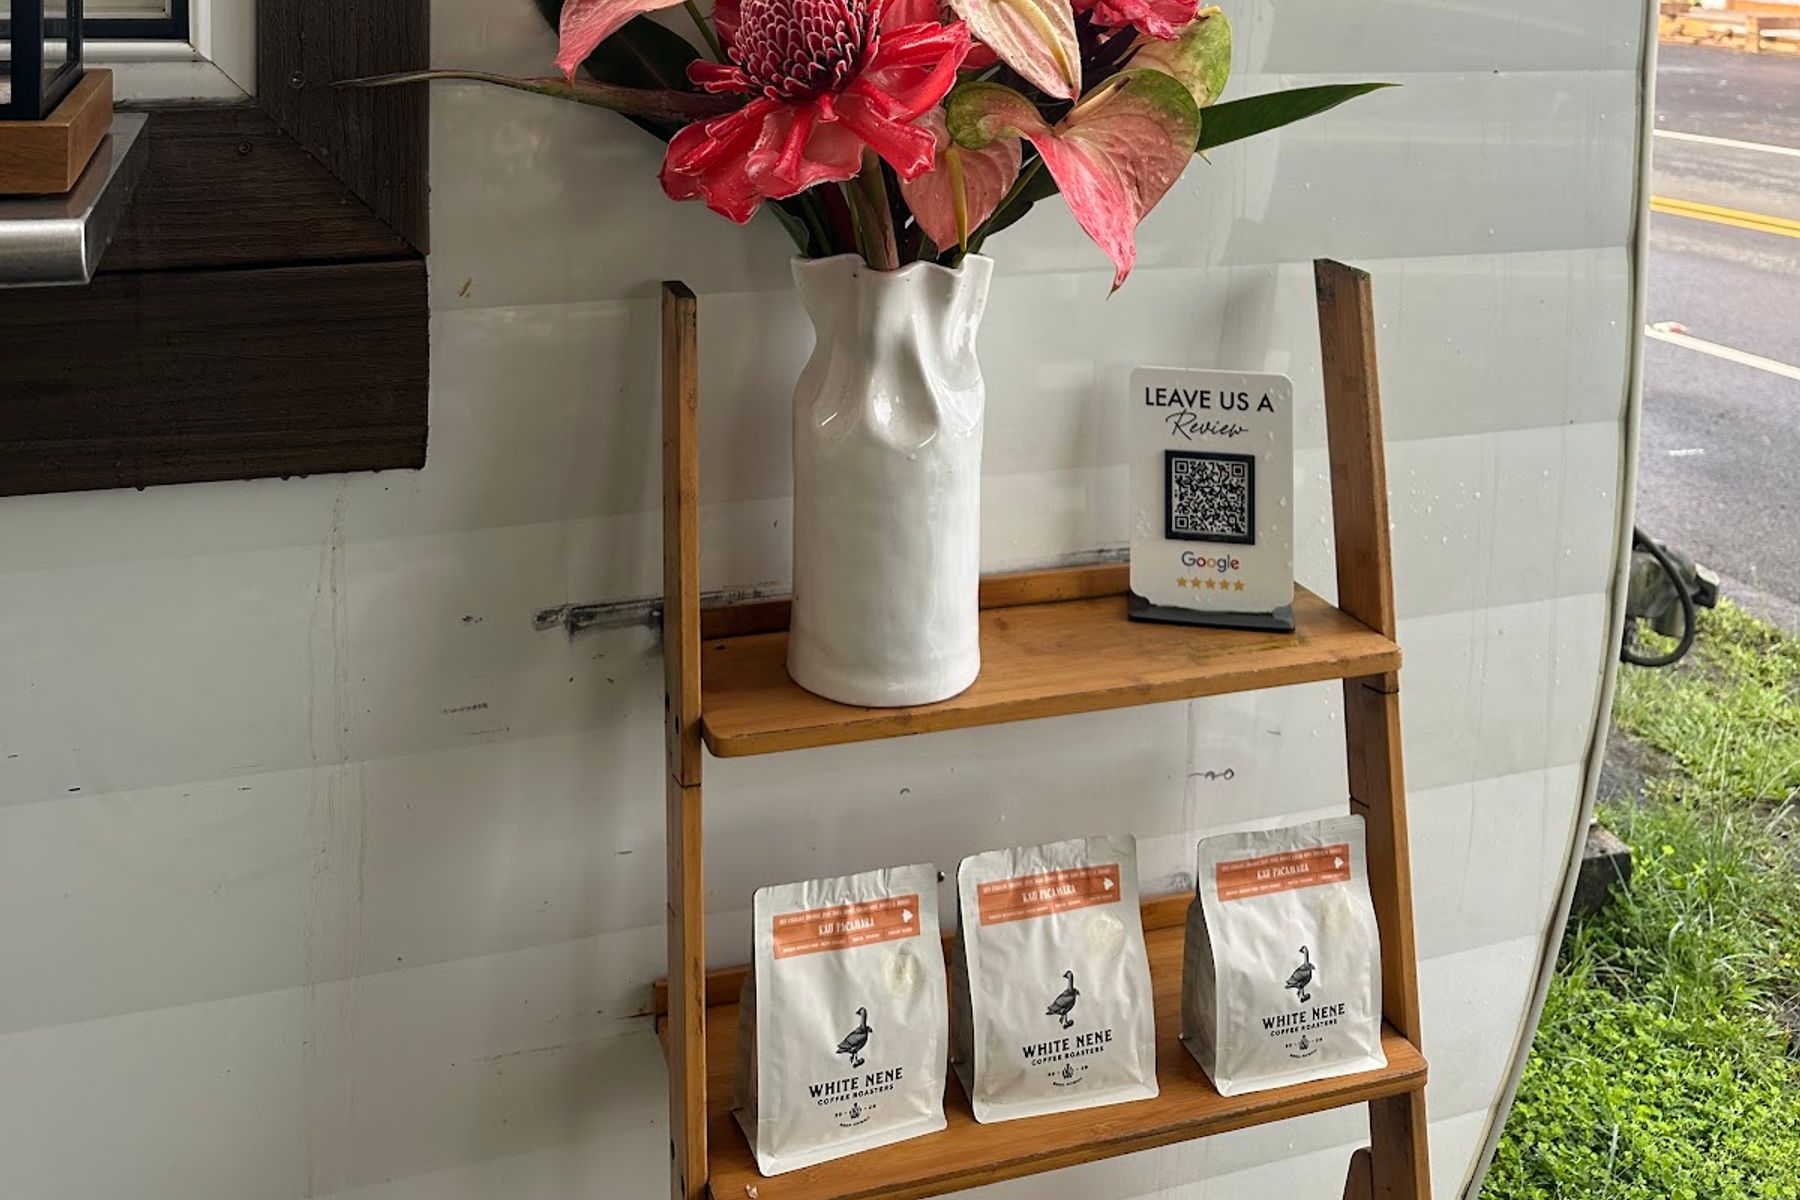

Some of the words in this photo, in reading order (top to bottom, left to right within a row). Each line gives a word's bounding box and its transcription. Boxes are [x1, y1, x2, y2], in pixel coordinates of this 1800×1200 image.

[1146, 387, 1211, 409] LEAVE
[1220, 392, 1249, 411] US
[1257, 393, 1274, 412] A
[1165, 408, 1249, 441] Review
[1181, 551, 1240, 573] Google
[1262, 1011, 1306, 1030] WHITE
[1312, 1002, 1345, 1020] NENE
[1022, 1038, 1070, 1058] WHITE
[1076, 1029, 1112, 1048] NENE
[1270, 1026, 1299, 1036] COFFEE
[1031, 1054, 1062, 1066] COFFEE
[1065, 1045, 1104, 1059] ROASTERS
[809, 1077, 859, 1098] WHITE
[865, 1067, 903, 1087] NENE
[817, 1093, 850, 1106] COFFEE
[853, 1083, 894, 1099] ROASTERS
